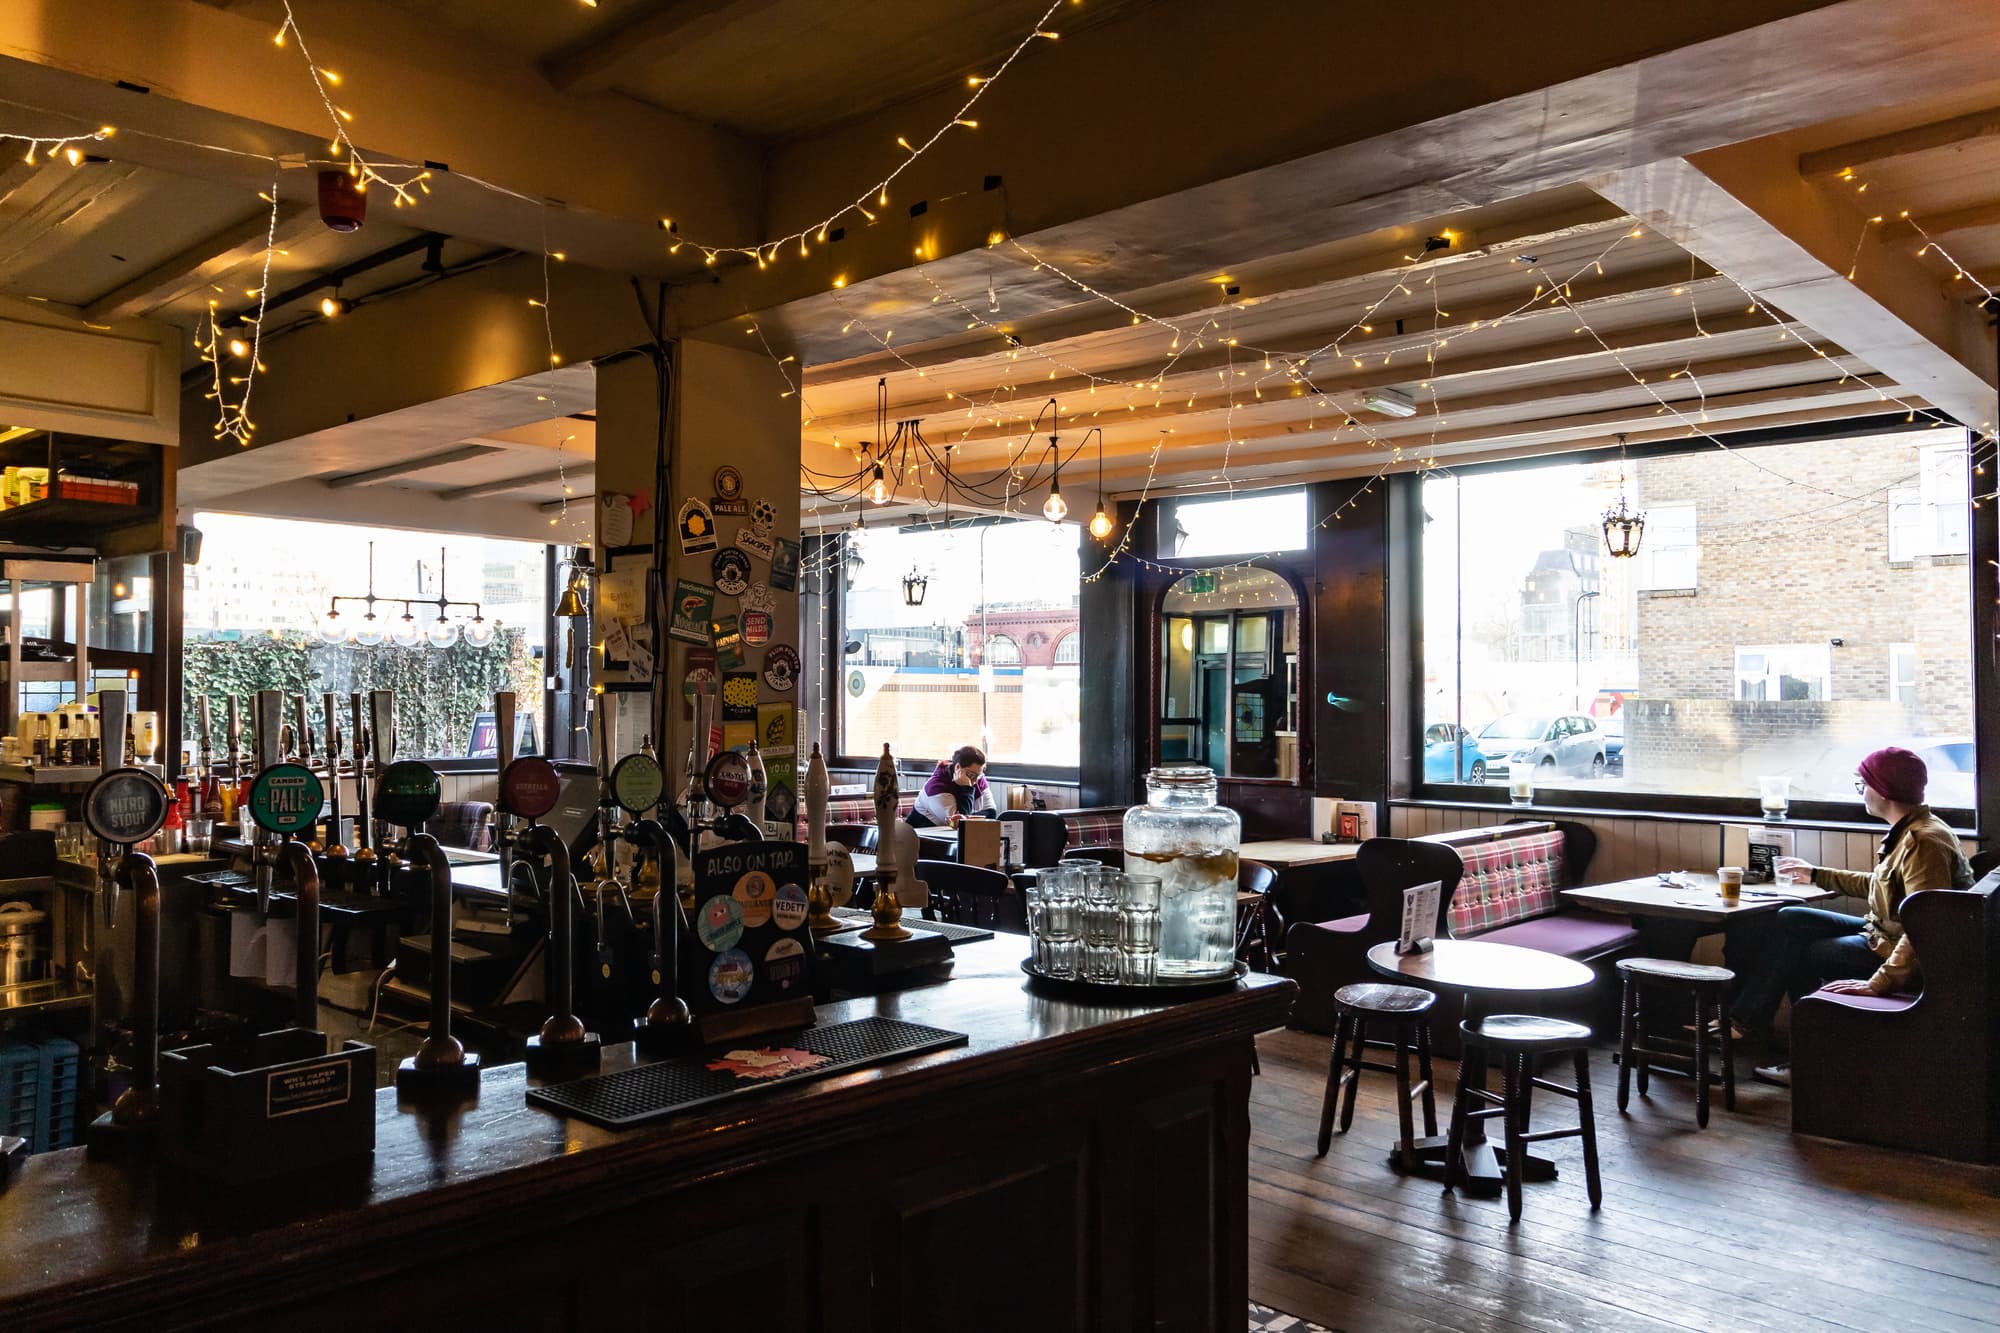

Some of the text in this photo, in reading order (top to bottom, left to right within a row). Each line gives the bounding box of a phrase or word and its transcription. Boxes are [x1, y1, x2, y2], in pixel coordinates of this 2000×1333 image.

[714, 503, 732, 513] PALE
[733, 503, 746, 513] ALE
[746, 616, 766, 625] SEND
[110, 796, 146, 814] NITRO
[270, 787, 305, 813] PALE
[111, 811, 146, 828] STOUT
[707, 849, 794, 878] ALSO ON TAP
[775, 900, 806, 913] VEDETT
